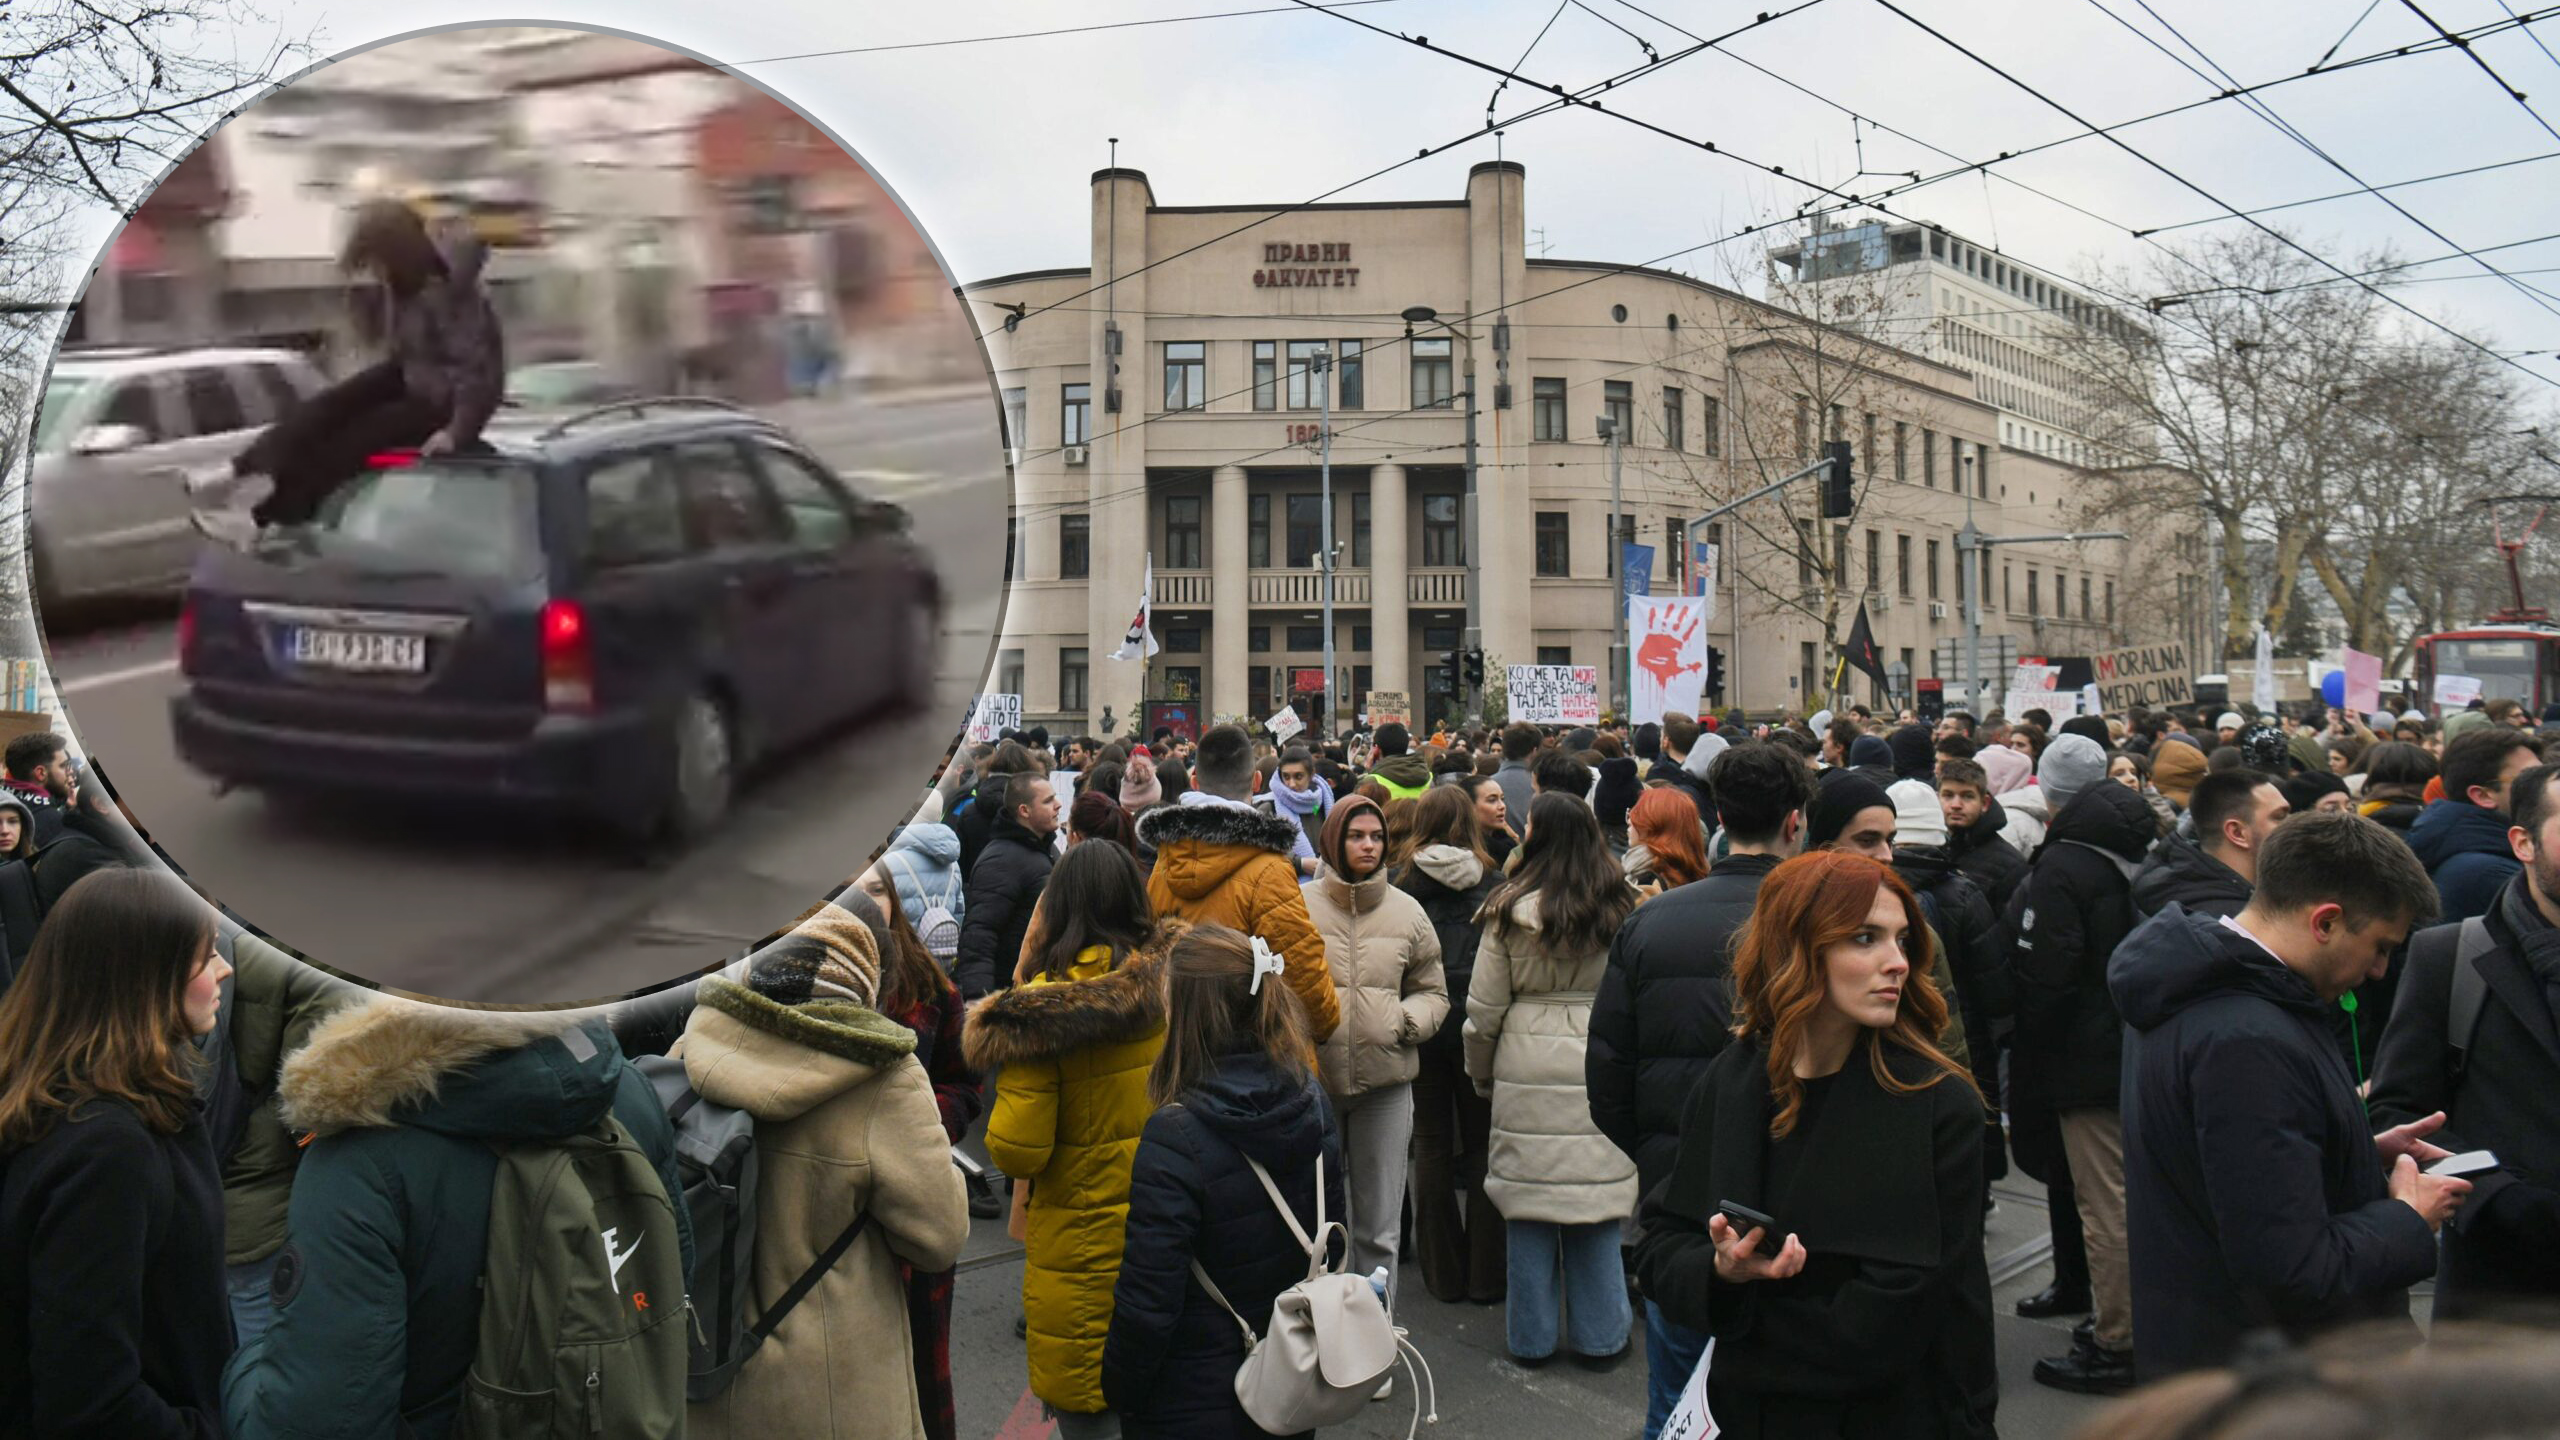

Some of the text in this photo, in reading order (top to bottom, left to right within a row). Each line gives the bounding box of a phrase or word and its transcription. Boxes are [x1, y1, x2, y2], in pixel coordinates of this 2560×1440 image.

[1264, 242, 1351, 262] ПРАВНИ
[1253, 268, 1360, 287] ФАКУЛТЕТ
[2094, 645, 2187, 681] (M)ORALNA
[1508, 666, 1523, 680] КО
[1527, 667, 1548, 680] СМЕ
[1553, 667, 1574, 681] ТАЈ
[1509, 681, 1523, 694] КО
[1525, 682, 1537, 694] НЕ
[1540, 681, 1558, 694] ЗНА
[1559, 681, 1573, 694] ЗА
[2098, 677, 2190, 711] MEDICINA
[982, 694, 1017, 711] НЕШТО
[1514, 694, 1535, 708] ТАЈ
[1538, 695, 1557, 708] ИДЕ
[983, 711, 1020, 728] ШТО ТЕ
[1526, 709, 1597, 721] ВОЈВОДА МИШИЋ
